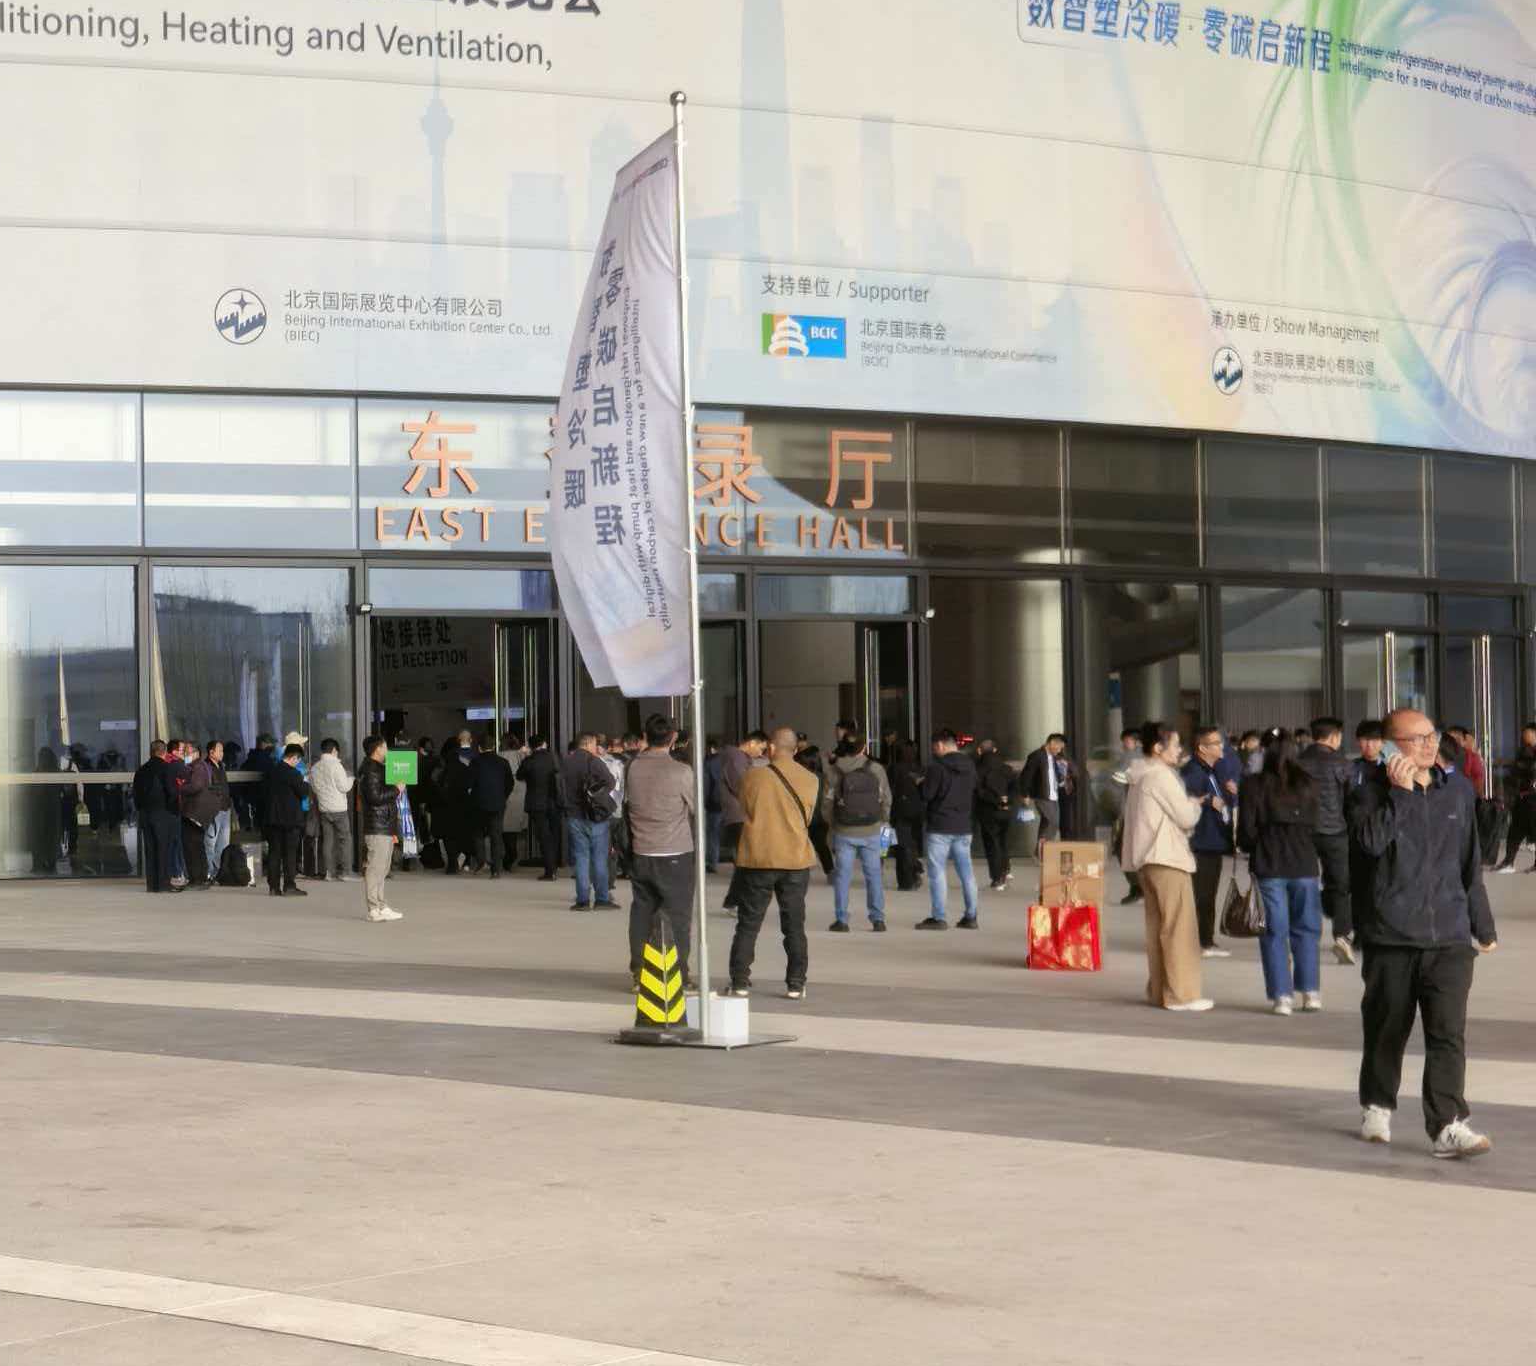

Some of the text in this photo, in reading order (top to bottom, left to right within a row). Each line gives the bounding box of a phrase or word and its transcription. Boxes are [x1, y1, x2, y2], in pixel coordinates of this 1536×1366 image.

[161, 8, 294, 55] Heating
[305, 18, 365, 53] and
[376, 23, 553, 71] Ventilation,
[761, 275, 830, 297] 支持单位
[849, 281, 929, 303] Supporter
[285, 289, 502, 318] 北京国际展览中心有限公司
[285, 314, 325, 329] Beijing
[329, 316, 405, 330] International
[409, 318, 465, 332] Exhibition
[469, 321, 505, 334] Center
[810, 327, 837, 339] BCIC
[861, 319, 946, 340] 北京国际商会
[402, 410, 893, 510] 东录厅
[376, 506, 496, 543] EAST
[799, 514, 904, 550] HALL
